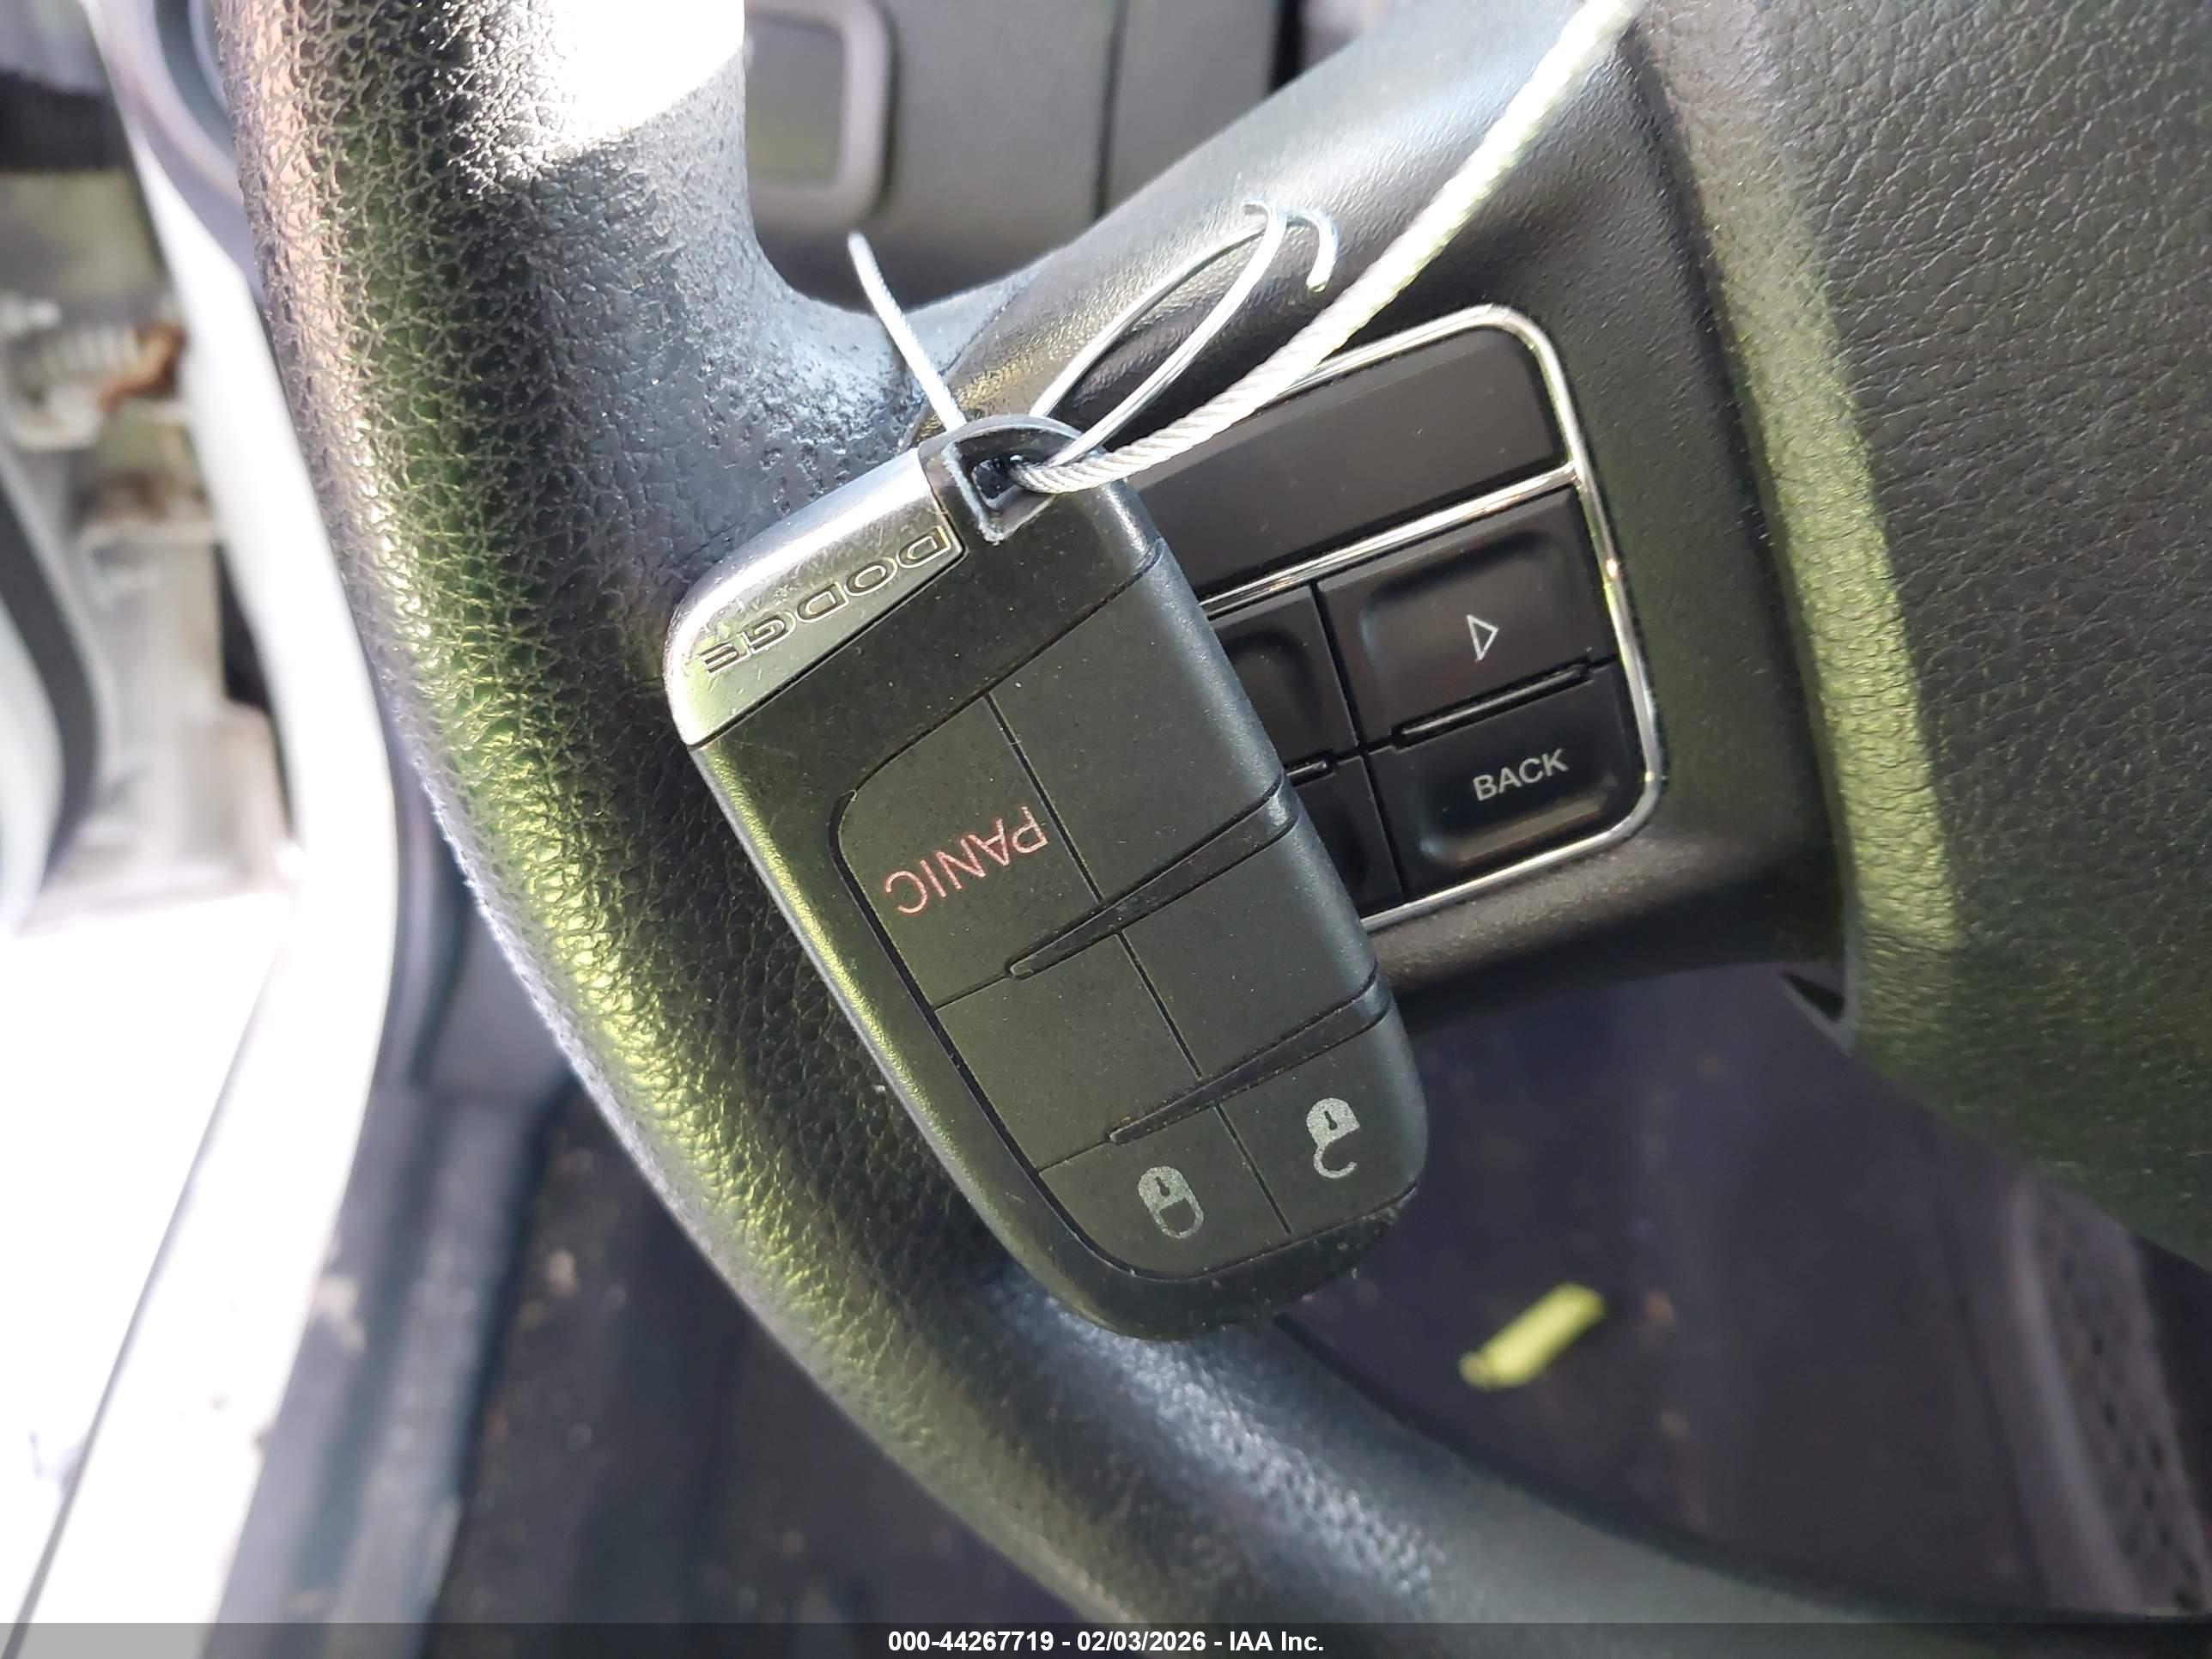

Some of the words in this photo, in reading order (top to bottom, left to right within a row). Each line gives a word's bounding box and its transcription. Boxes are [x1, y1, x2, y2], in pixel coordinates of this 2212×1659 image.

[698, 526, 951, 674] DODGE
[1472, 747, 1570, 802] BACK
[883, 805, 1049, 915] PANIC
